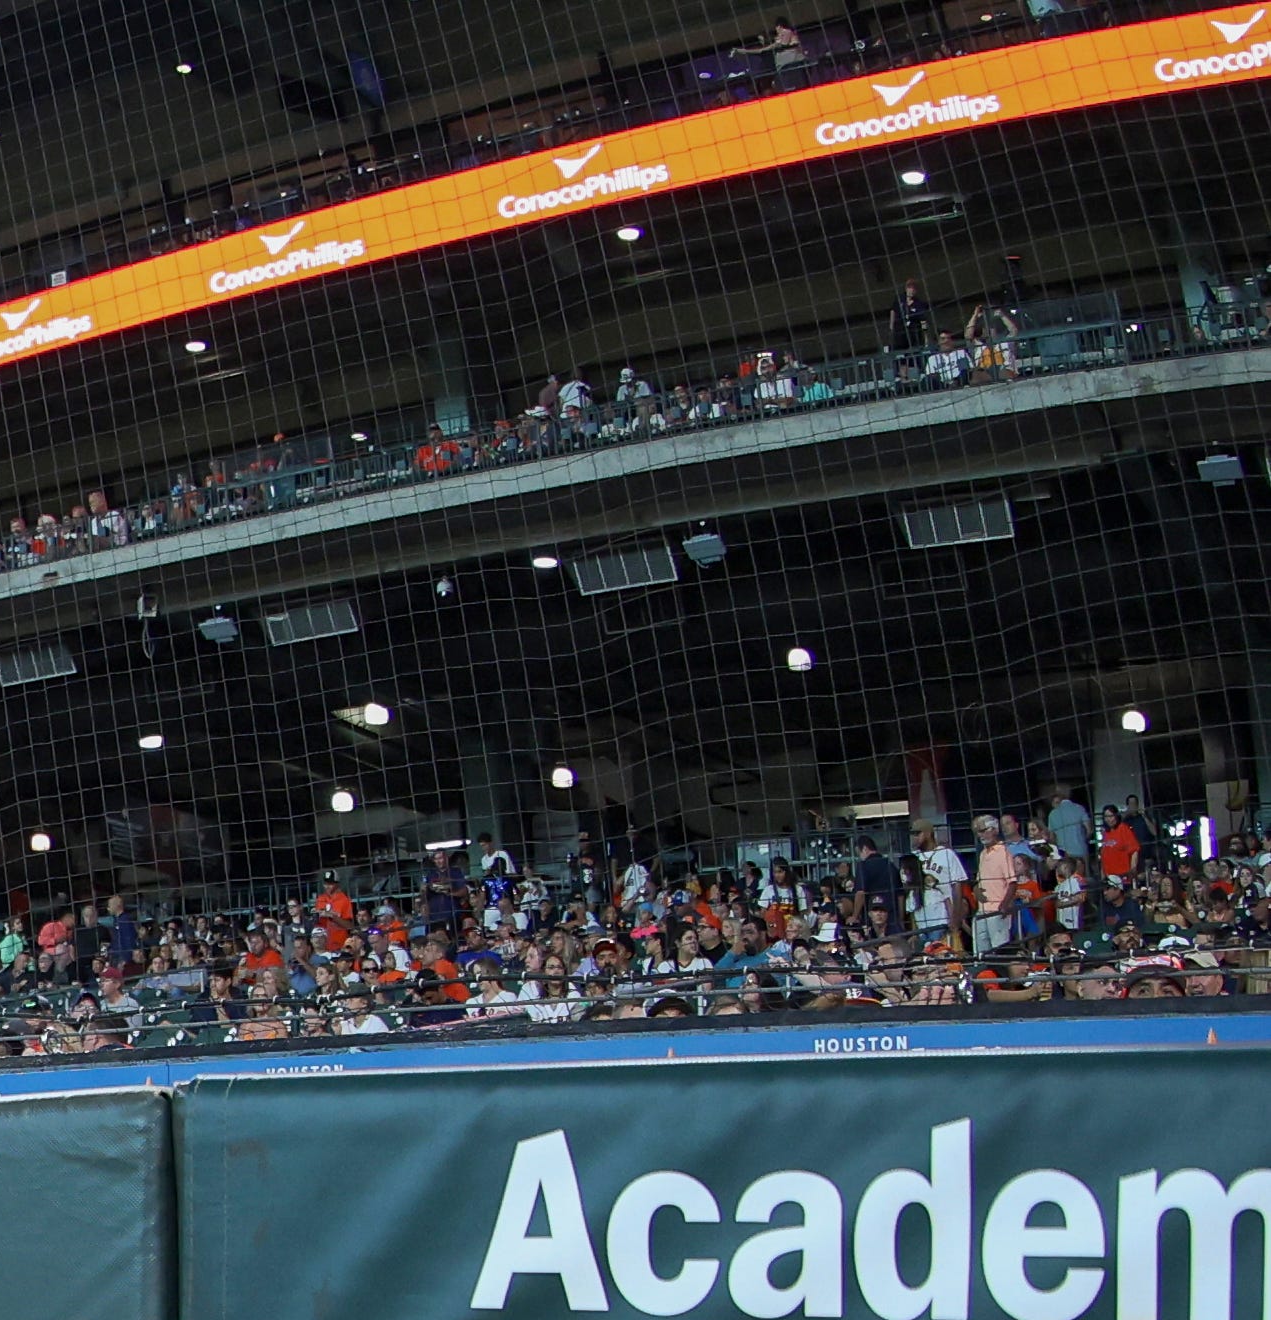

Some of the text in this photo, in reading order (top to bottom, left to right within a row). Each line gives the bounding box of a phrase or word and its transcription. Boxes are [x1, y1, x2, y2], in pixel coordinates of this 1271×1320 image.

[815, 94, 1001, 146] ConocoPhillips
[498, 164, 669, 218] ConocoPhillips
[210, 239, 365, 294] ConocoPhillips
[814, 1036, 909, 1053] HOUSTON
